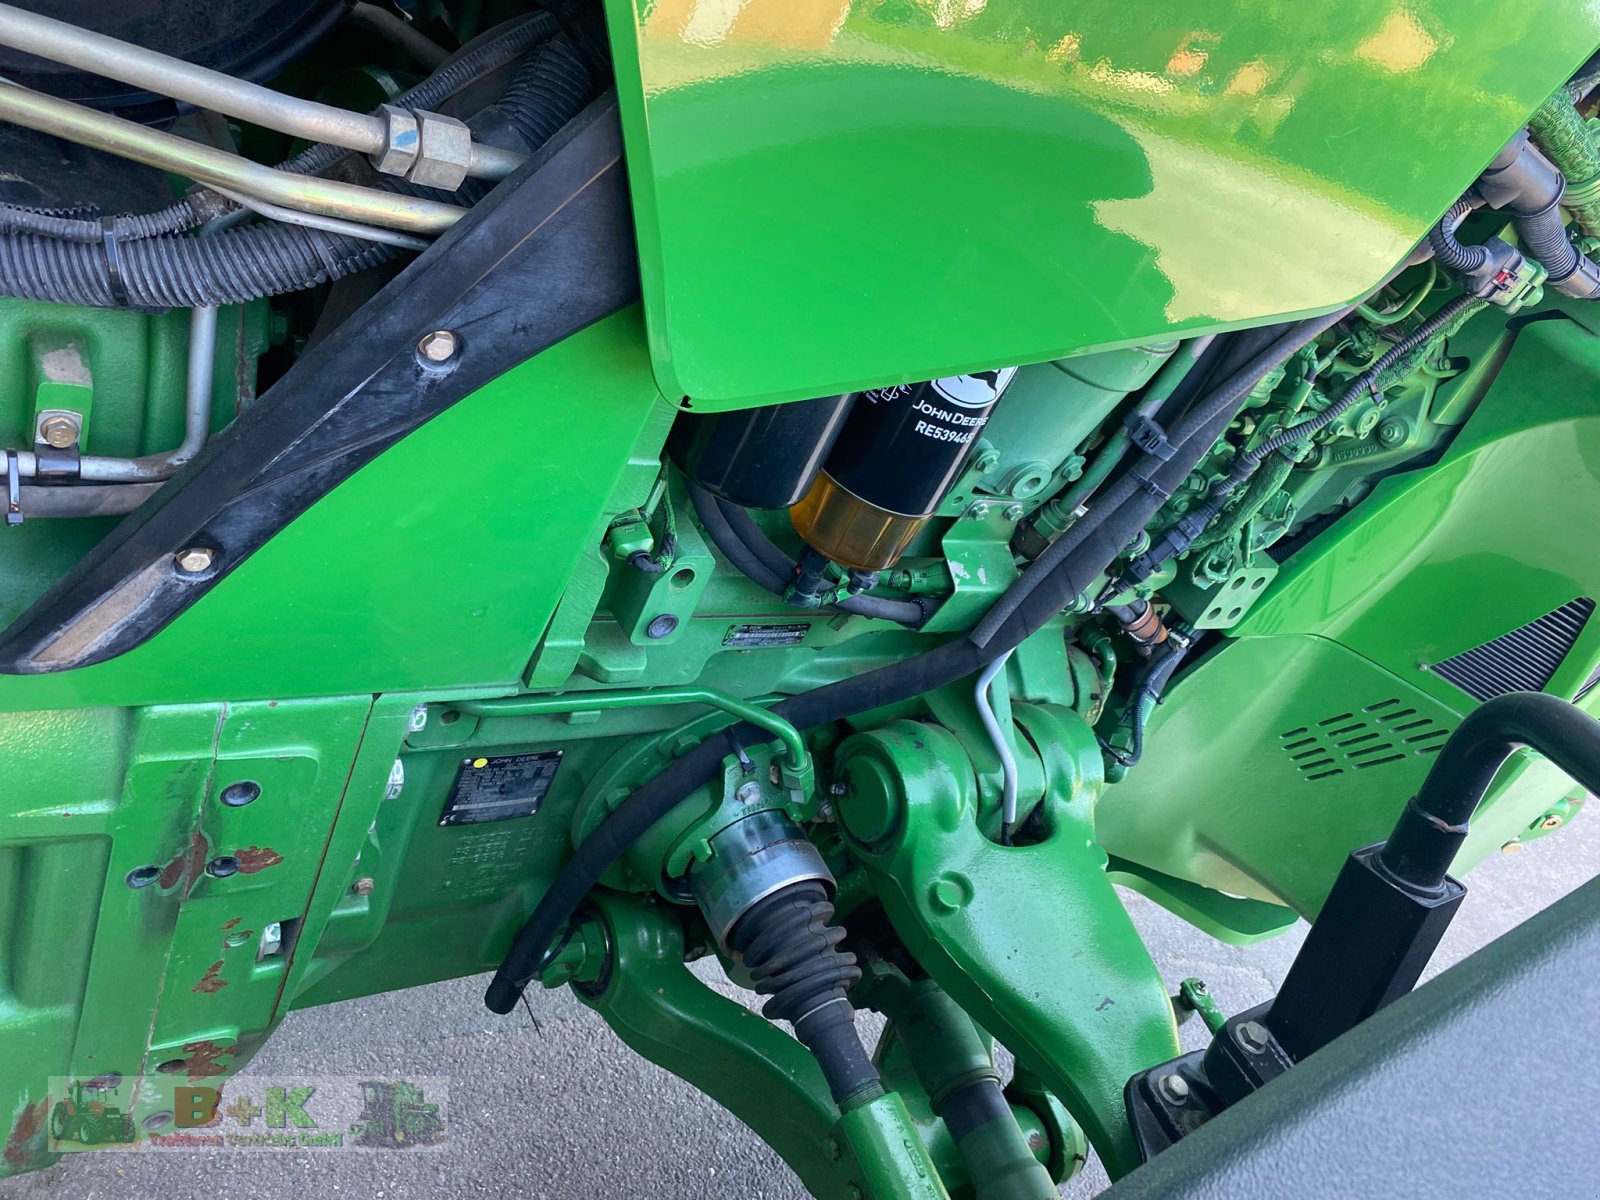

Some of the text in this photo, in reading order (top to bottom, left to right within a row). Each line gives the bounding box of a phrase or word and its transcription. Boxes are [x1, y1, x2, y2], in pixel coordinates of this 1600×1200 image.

[912, 399, 989, 427] JOHN DEERE
[914, 420, 974, 444] RE539465
[516, 755, 539, 763] DEERE
